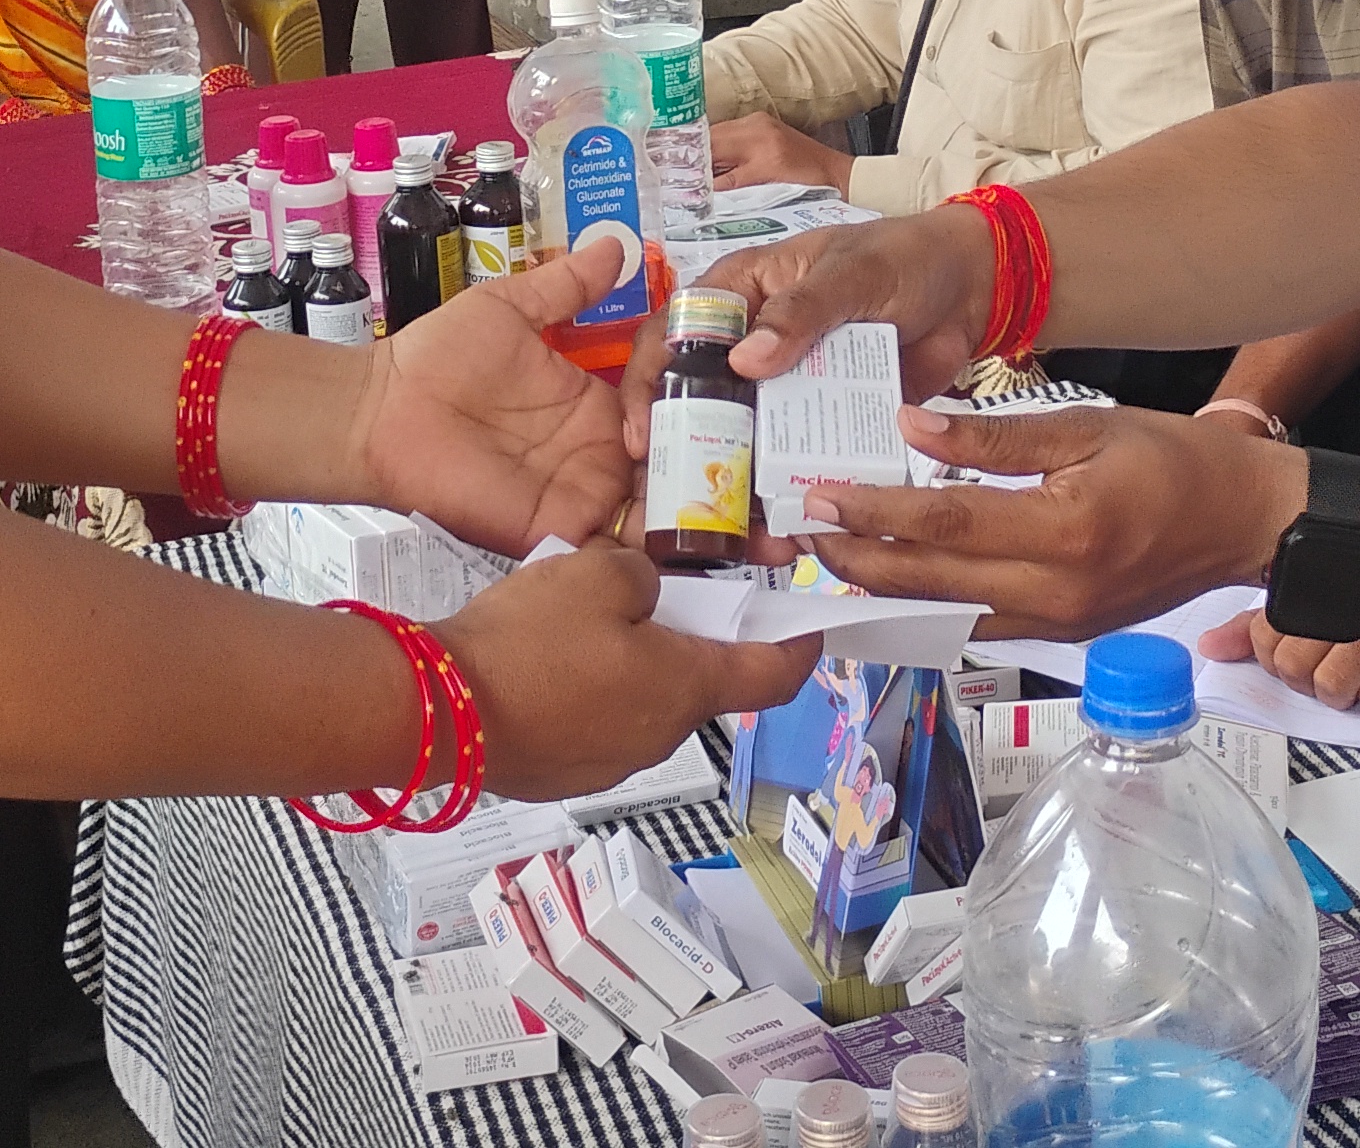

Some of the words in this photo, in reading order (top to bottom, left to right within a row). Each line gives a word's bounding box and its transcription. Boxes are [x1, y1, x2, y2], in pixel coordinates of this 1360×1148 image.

[571, 158, 617, 176] Cetrimide
[618, 155, 627, 169] &
[567, 171, 633, 191] Chlorhexidine
[576, 185, 626, 203] Gluconate
[582, 201, 622, 217] Solution
[605, 303, 625, 314] Litre
[612, 794, 682, 816] Blocacid-D
[649, 914, 716, 976] Blocacid-D
